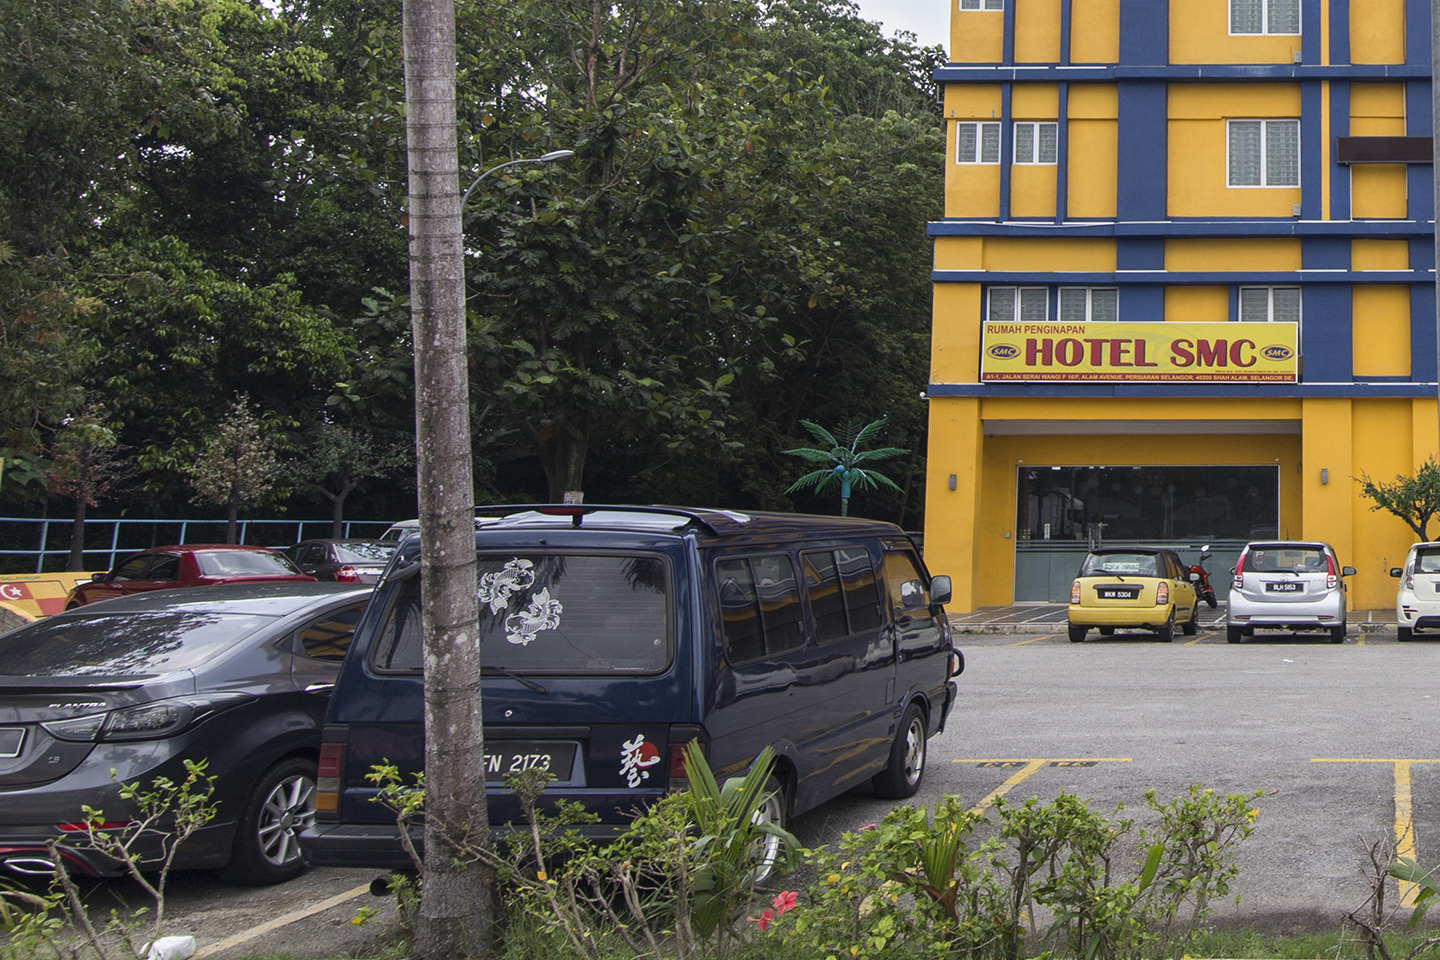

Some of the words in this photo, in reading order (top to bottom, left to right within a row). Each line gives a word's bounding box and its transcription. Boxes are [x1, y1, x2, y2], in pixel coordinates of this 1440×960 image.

[987, 325, 1022, 334] RUMAH
[1024, 325, 1086, 334] PENGINAPAN
[1025, 338, 1158, 367] HOTEL
[1170, 338, 1257, 368] SMC
[1266, 349, 1288, 357] SMC
[510, 754, 551, 773] 2173
